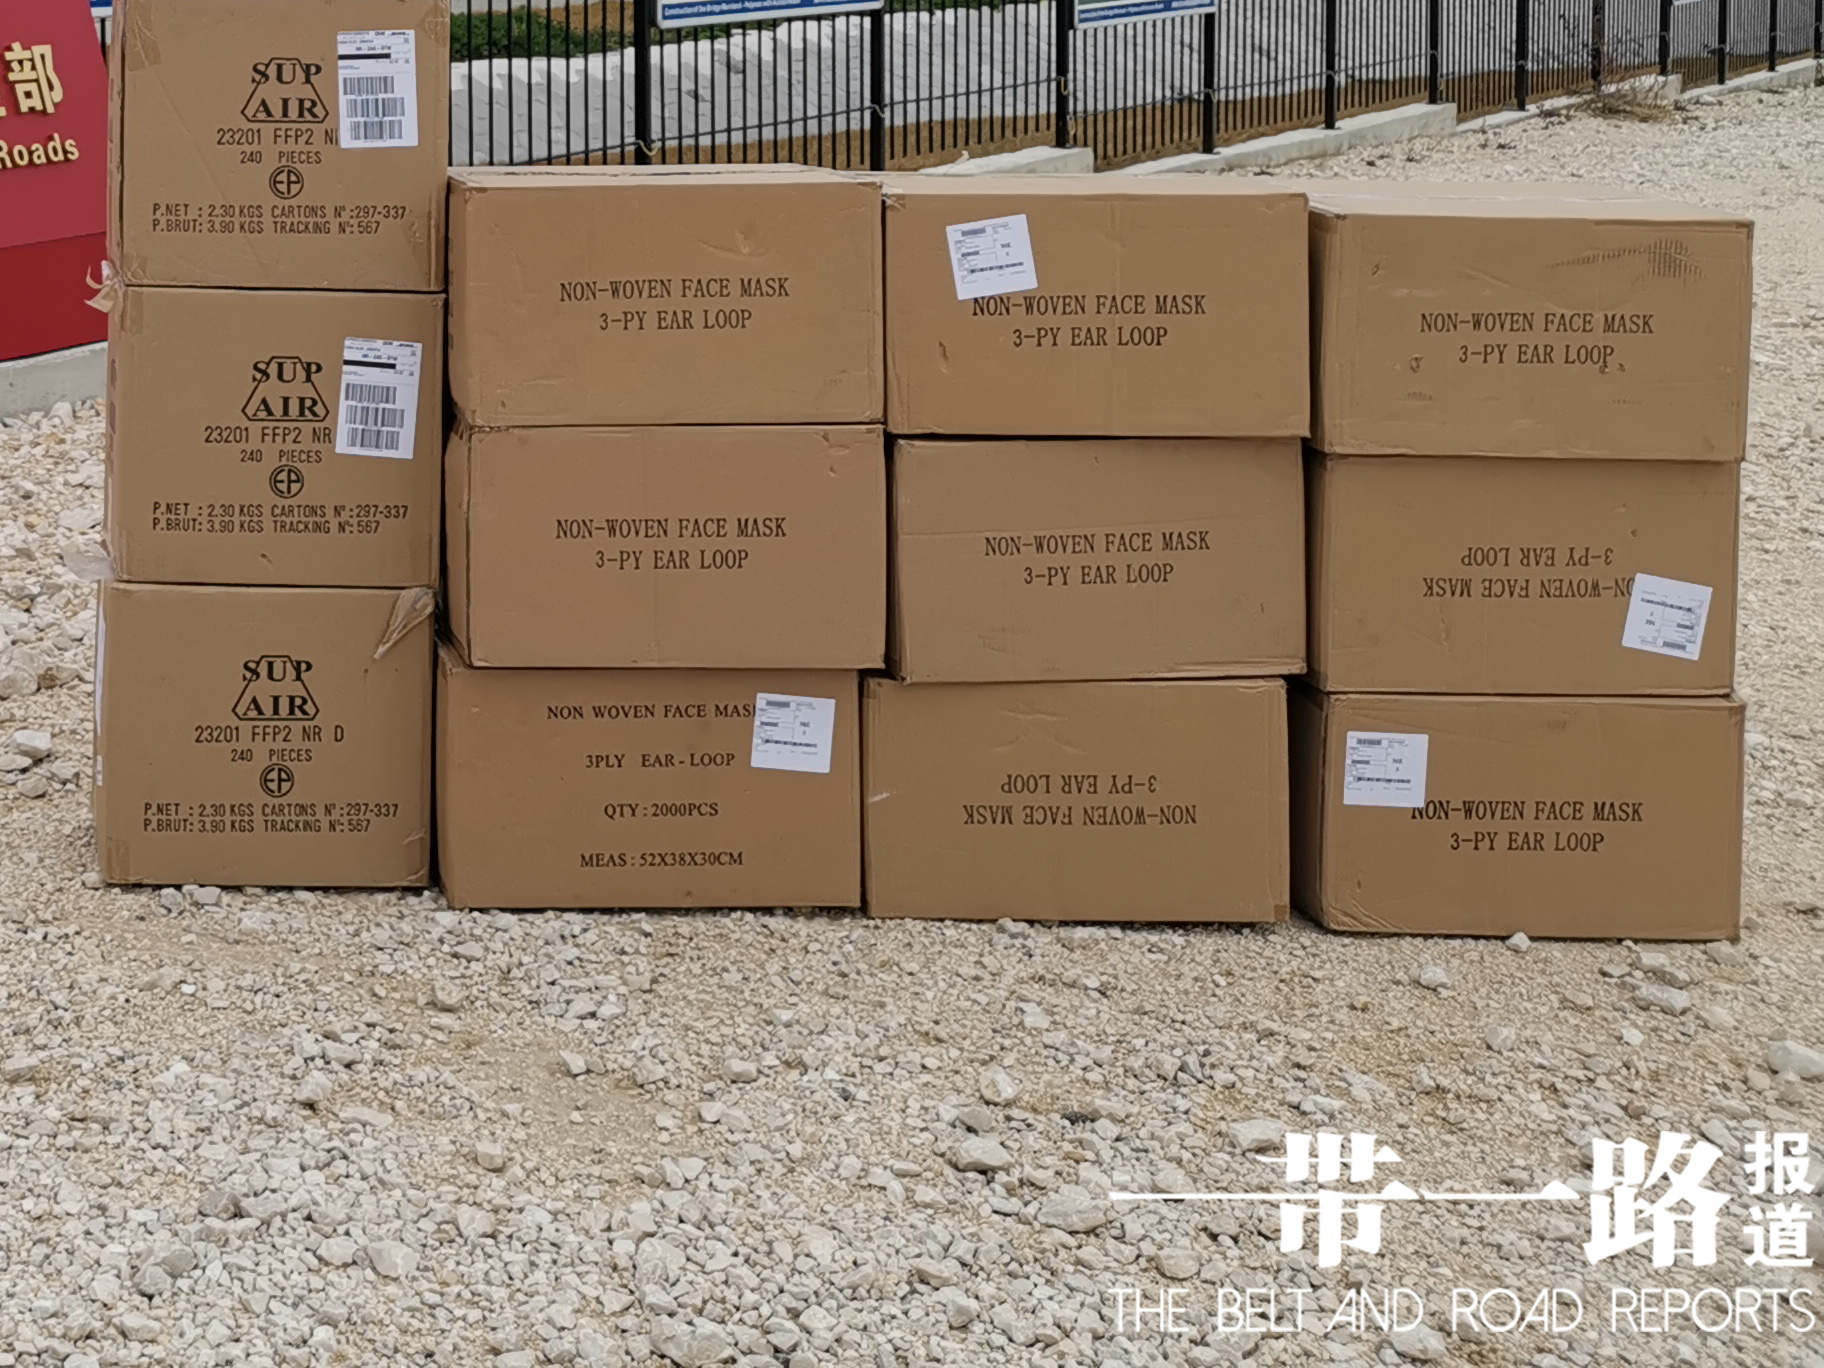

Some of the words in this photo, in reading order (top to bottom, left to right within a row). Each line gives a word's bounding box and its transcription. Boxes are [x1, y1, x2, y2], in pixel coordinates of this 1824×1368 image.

[251, 62, 322, 85] SUP
[250, 97, 320, 120] AIR
[216, 127, 262, 146] 23201
[273, 127, 315, 146] FFP2
[324, 128, 338, 146] N
[240, 150, 263, 164] 240
[278, 150, 323, 167] PIECES
[152, 202, 190, 218] P.NET
[207, 203, 236, 219] 2.30
[238, 204, 264, 219] KGS
[270, 204, 327, 220] CARTONS
[207, 218, 235, 234] 3.90
[239, 219, 264, 235] KGS
[272, 220, 331, 235] TRACKING
[357, 219, 381, 235] 567
[559, 278, 673, 303] NON-WOVEN
[680, 277, 731, 298] FACE
[739, 277, 790, 298] MASK
[971, 295, 1089, 317] NON-WOVEN
[1095, 294, 1146, 315] FACE
[1154, 294, 1206, 315] MASK
[599, 310, 648, 331] 3-PY
[656, 309, 695, 330] EAR
[702, 308, 753, 330] LOOP
[1419, 311, 1535, 333] NON-WOVEN
[1543, 312, 1594, 333] FACE
[1602, 313, 1654, 334] MASK
[1012, 326, 1061, 348] 3-PY
[1070, 326, 1109, 347] EAR
[1117, 325, 1168, 347] LOOP
[1458, 343, 1508, 365] 3-PY
[1516, 343, 1555, 365] EAR
[1564, 344, 1615, 365] LOOP
[252, 360, 323, 384] SUP
[251, 396, 320, 418] AIR
[204, 425, 249, 444] 23201
[260, 425, 303, 445] FFP2
[311, 426, 332, 444] NR
[240, 448, 263, 464] 240
[278, 448, 323, 466] PIECES
[152, 501, 190, 519] P.NET
[207, 503, 236, 518] 2.30
[238, 503, 264, 518] KGS
[270, 503, 327, 519] CARTONS
[206, 518, 235, 534] 3.90
[239, 519, 264, 534] KGS
[272, 519, 331, 535] TRACKING
[356, 519, 381, 534] 567
[555, 517, 669, 540] NON-WOVEN
[677, 517, 728, 538] FACE
[736, 516, 787, 538] MASK
[984, 533, 1096, 557] NON-WOVEN
[1104, 531, 1153, 553] FACE
[1161, 530, 1211, 552] MASK
[595, 549, 643, 571] 3-PY
[653, 549, 690, 570] EAR
[699, 548, 749, 570] LOOP
[1460, 546, 1511, 567] LOOP
[1519, 546, 1556, 568] EAR
[1564, 546, 1614, 567] 3-PY
[1024, 565, 1071, 587] 3-PY
[1080, 564, 1118, 585] EAR
[1126, 562, 1174, 584] LOOP
[1422, 577, 1473, 598] MASK
[1480, 578, 1531, 599] FACE
[1539, 576, 1635, 599] ON-WOVEN
[242, 660, 313, 683] SUP
[242, 695, 310, 717] AIR
[546, 705, 584, 720] NON
[591, 703, 656, 720] WOVEN
[663, 703, 707, 719] FACE
[714, 703, 755, 718] MAS
[194, 724, 240, 744] 23201
[251, 724, 292, 743] FFP2
[302, 724, 323, 743] NR
[333, 724, 345, 743] D
[230, 748, 254, 763] 240
[268, 748, 313, 765] PIECES
[585, 753, 626, 769] 3PLY
[1000, 773, 1051, 795] LOOP
[1060, 774, 1099, 795] EAR
[1107, 774, 1158, 795] 3-PY
[143, 801, 181, 817] P.NET
[197, 802, 227, 818] 2.30
[229, 802, 255, 818] KGS
[261, 802, 317, 818] CARTONS
[962, 804, 1014, 826] MASK
[1022, 804, 1073, 826] FACE
[1082, 804, 1198, 826] NON-WOVEN
[1410, 801, 1525, 821] NON-WOVEN
[1533, 800, 1585, 821] FACE
[1592, 800, 1643, 822] MASK
[197, 819, 226, 834] 3.90
[230, 819, 255, 834] KGS
[262, 819, 322, 833] TRACKING
[347, 818, 371, 833] 567
[1450, 831, 1499, 852] 3-PY
[1506, 831, 1545, 852] EAR
[1554, 831, 1605, 853] LOOP
